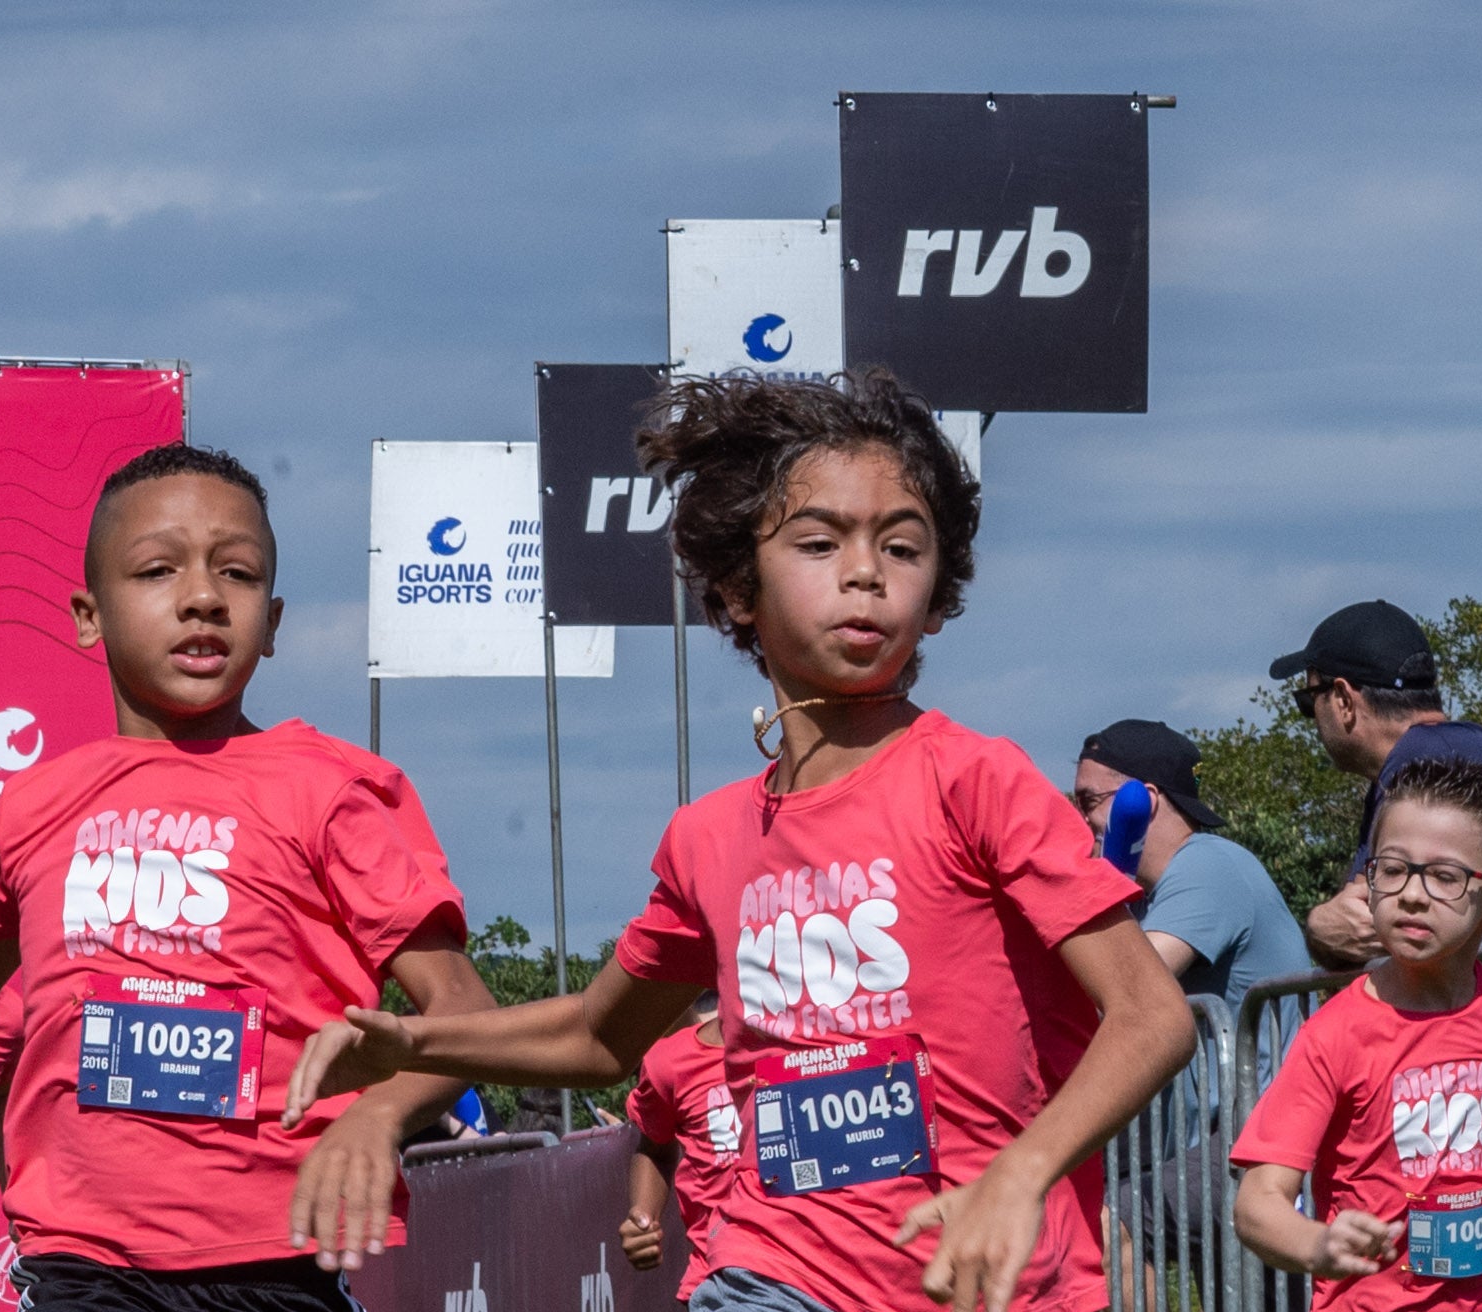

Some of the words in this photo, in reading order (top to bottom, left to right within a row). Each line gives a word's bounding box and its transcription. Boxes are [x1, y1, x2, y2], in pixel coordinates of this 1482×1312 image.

[897, 206, 1092, 298] rvb
[585, 477, 675, 533] rv
[399, 563, 493, 583] IGUANA
[397, 584, 493, 605] SPORTS
[74, 808, 239, 854] ATHENAS
[62, 846, 230, 934] KIDS
[739, 857, 898, 929] ATHENAS
[123, 922, 223, 955] FASTER
[736, 898, 910, 1021] KIDS
[121, 977, 174, 994] ATHENAS
[175, 980, 207, 997] KIDS
[84, 1004, 114, 1016] 250m
[801, 989, 913, 1039] FASTER
[129, 1021, 235, 1062] 10032
[784, 1047, 834, 1070] ATHENAS
[835, 1041, 868, 1060] KIDS
[82, 1055, 109, 1070] 2016
[160, 1062, 201, 1076] IBRAHIM
[755, 1090, 782, 1104] 250m
[799, 1081, 915, 1133] 10043
[845, 1127, 885, 1144] MURILO
[759, 1144, 788, 1161] 2016
[1410, 1244, 1432, 1254] 2017
